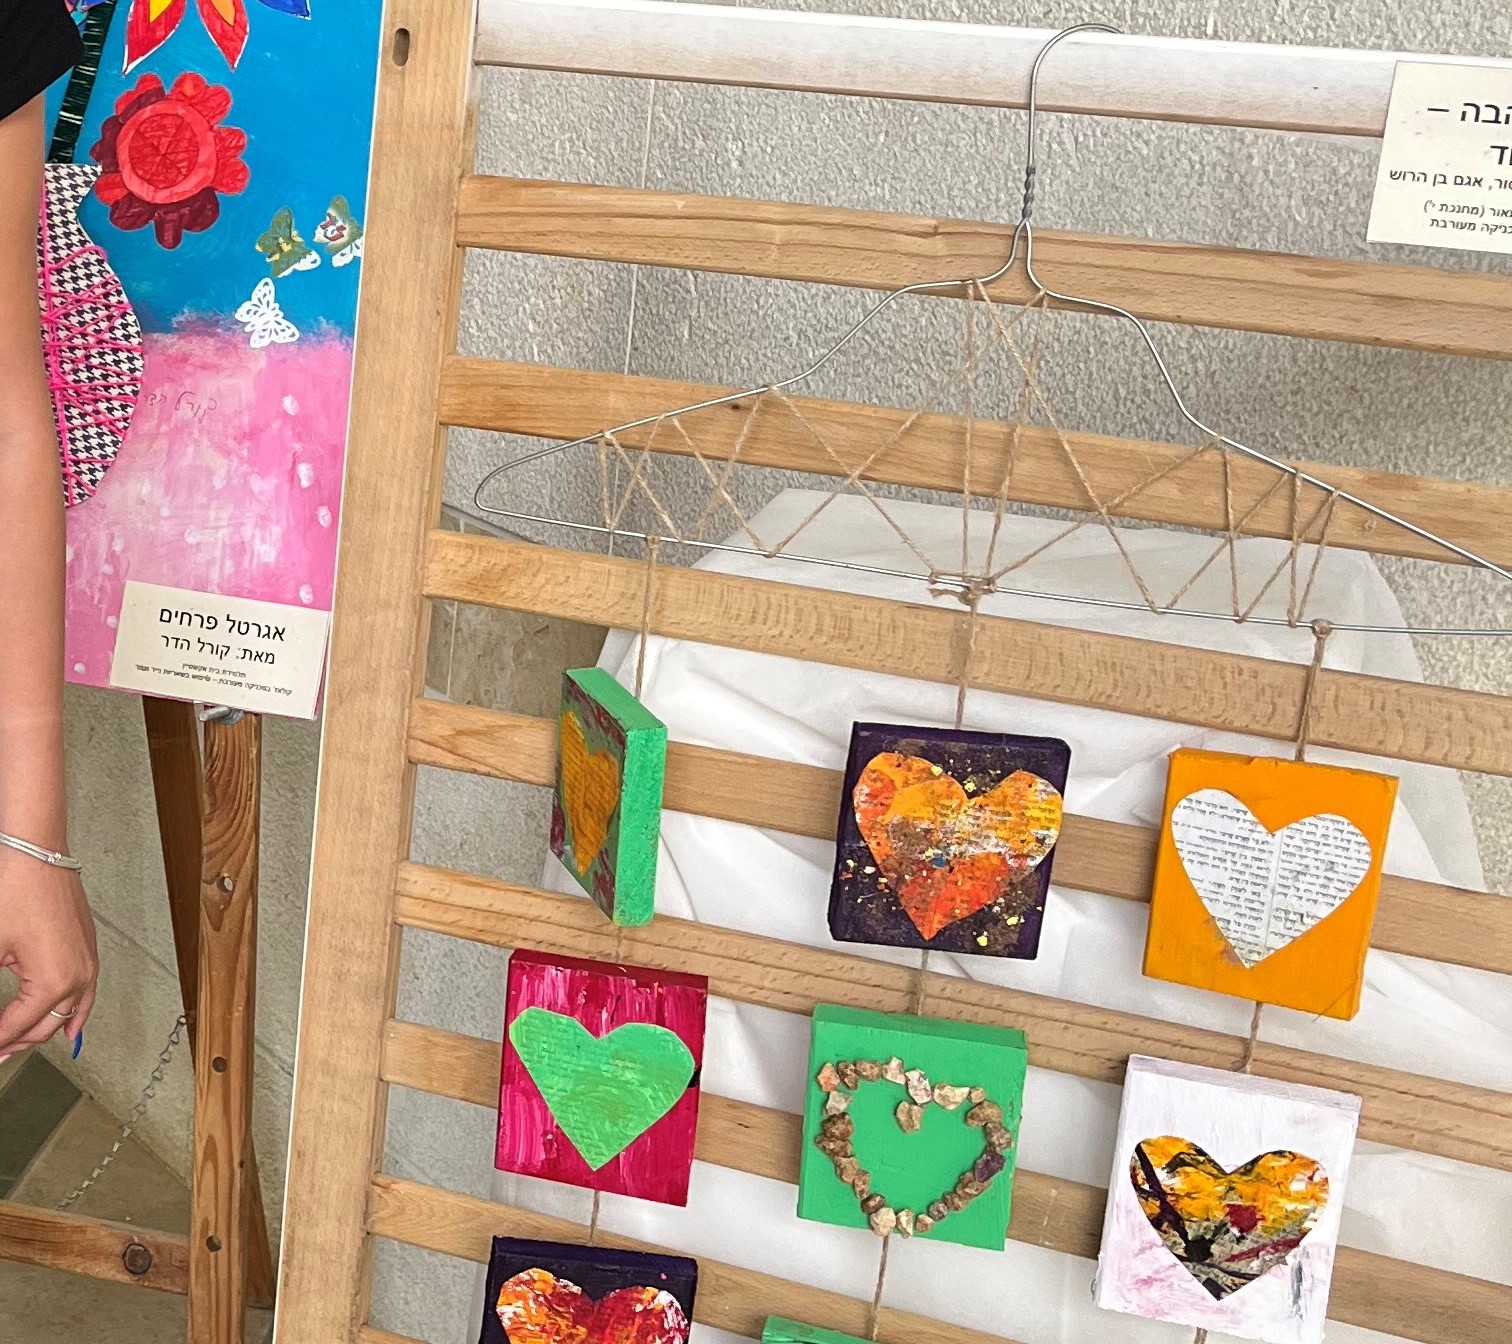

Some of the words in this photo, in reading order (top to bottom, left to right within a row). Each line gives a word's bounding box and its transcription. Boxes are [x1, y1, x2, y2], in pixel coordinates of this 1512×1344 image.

[1389, 169, 1427, 182] הרוש
[1432, 173, 1447, 187] בן
[1453, 174, 1483, 187] אגם
[1429, 218, 1476, 231] מעורבת
[159, 607, 218, 630] פרחים
[225, 613, 285, 641] אגרטל
[160, 634, 190, 651] הדר
[197, 636, 230, 660] קורל
[235, 647, 275, 664] מאת:
